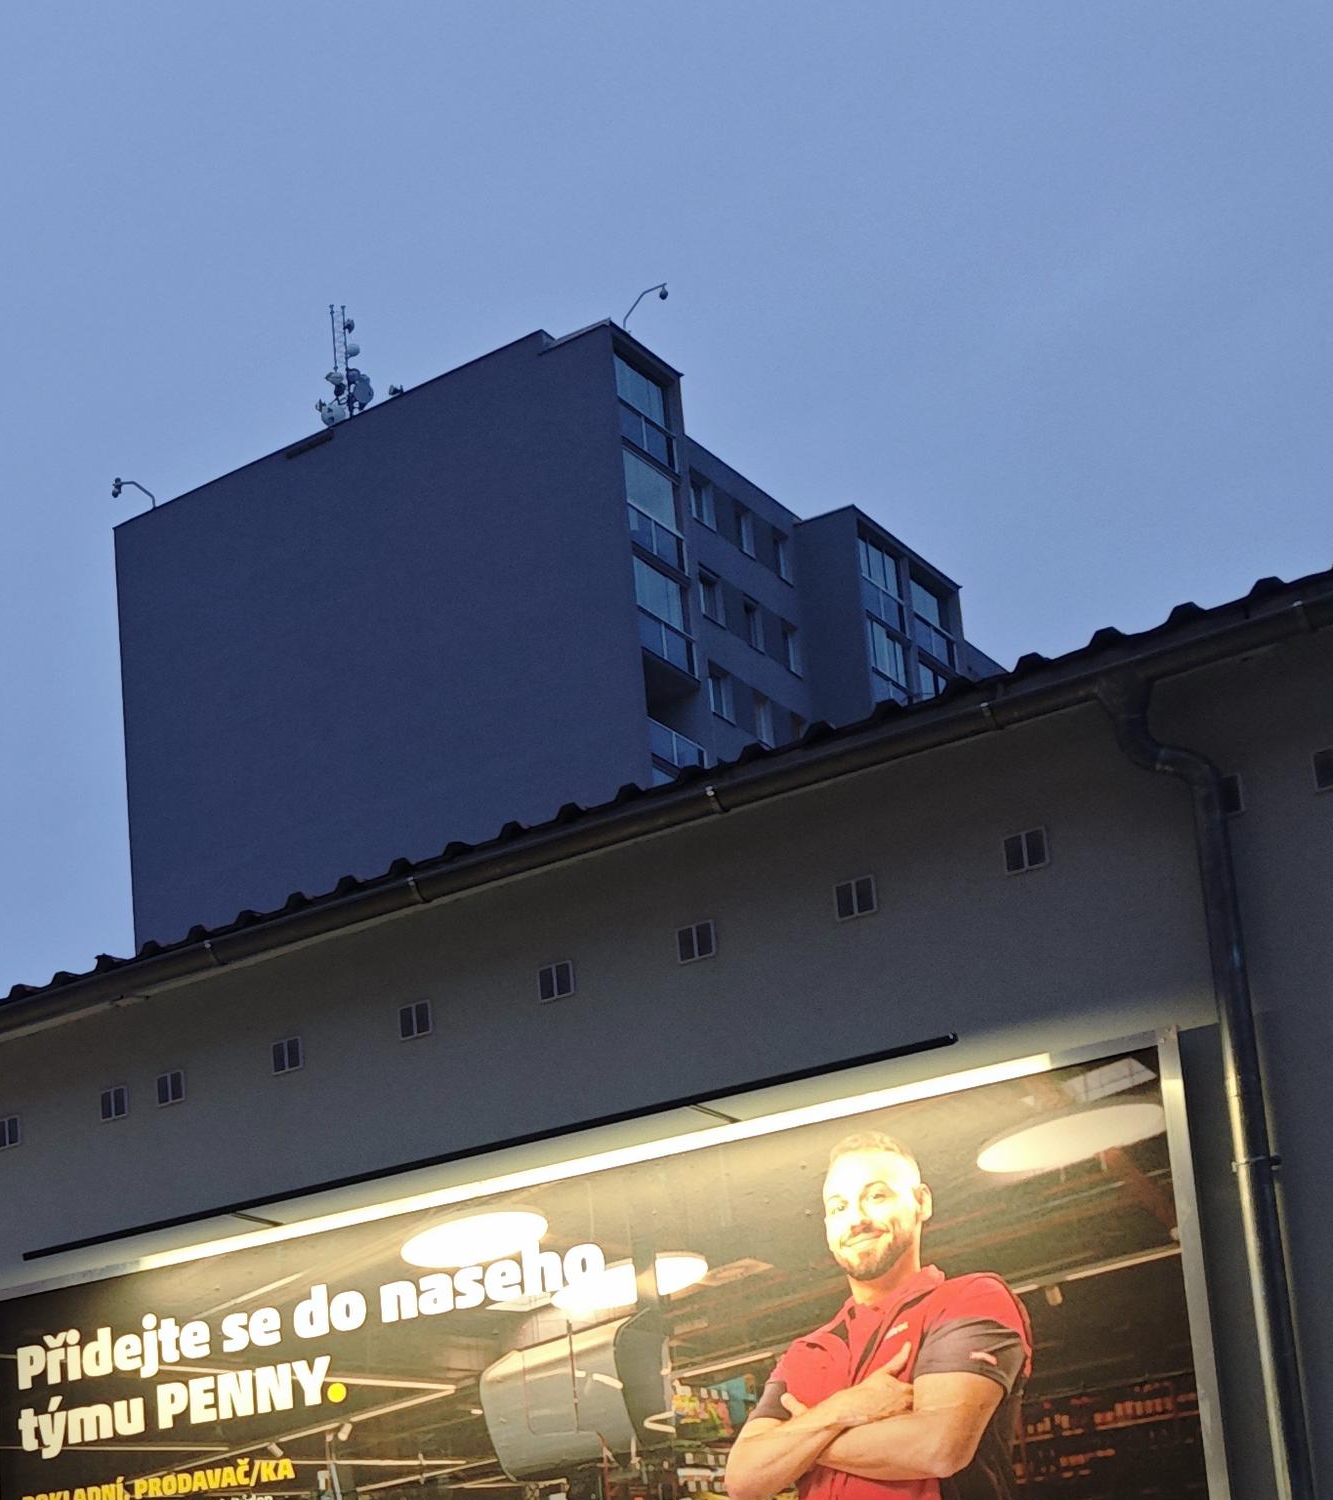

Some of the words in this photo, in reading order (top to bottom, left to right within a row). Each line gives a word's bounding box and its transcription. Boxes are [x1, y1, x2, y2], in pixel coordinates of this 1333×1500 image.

[17, 1313, 211, 1390] Přidejte
[222, 1307, 282, 1352] se
[294, 1284, 367, 1340] do
[18, 1395, 145, 1459] týmu
[156, 1355, 347, 1430] PENNY.
[134, 1458, 296, 1500] PRODAVAČ/KA
